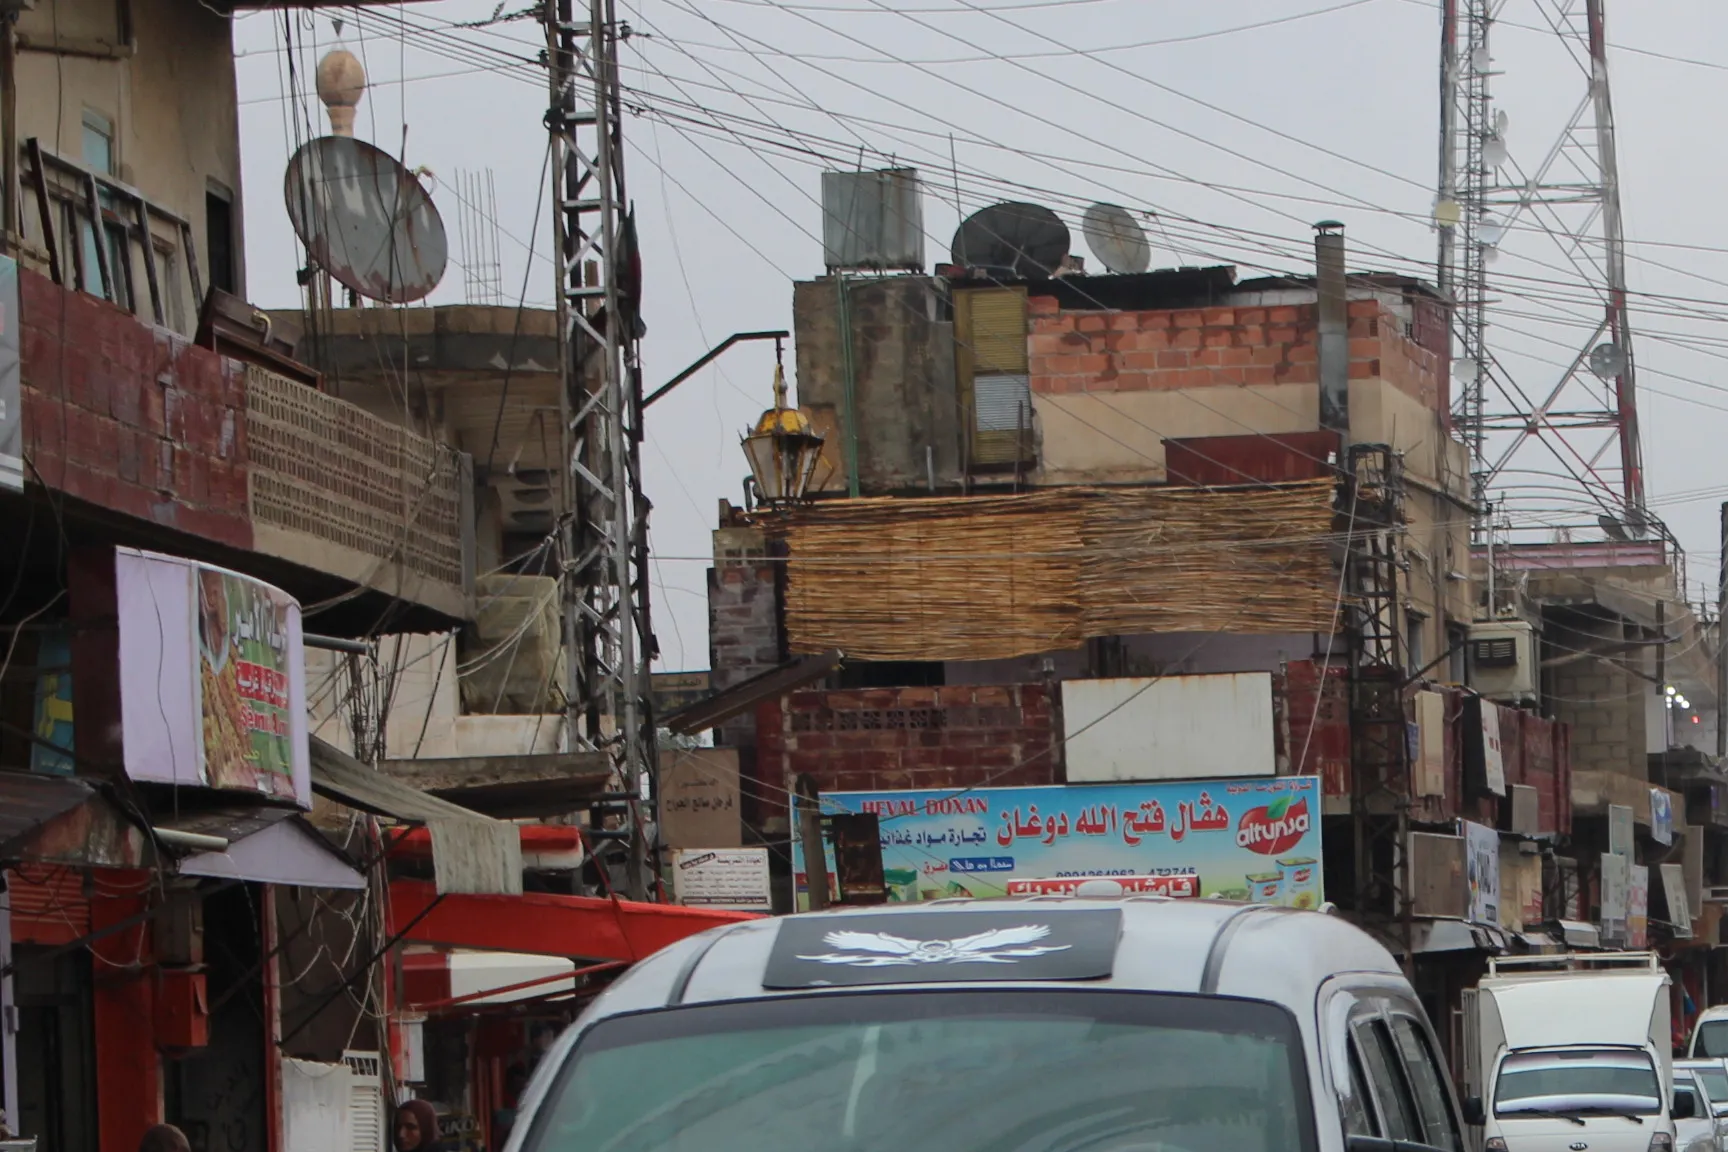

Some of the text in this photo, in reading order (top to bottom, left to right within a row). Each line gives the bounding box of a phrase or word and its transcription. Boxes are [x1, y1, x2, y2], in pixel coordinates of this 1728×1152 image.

[862, 798, 988, 817] HEVAL DOXAN
[1075, 804, 1117, 836] الله
[996, 804, 1070, 848] دوغان
[1122, 799, 1165, 847] فتح
[916, 830, 946, 848] مواد
[949, 827, 986, 847] تجارة
